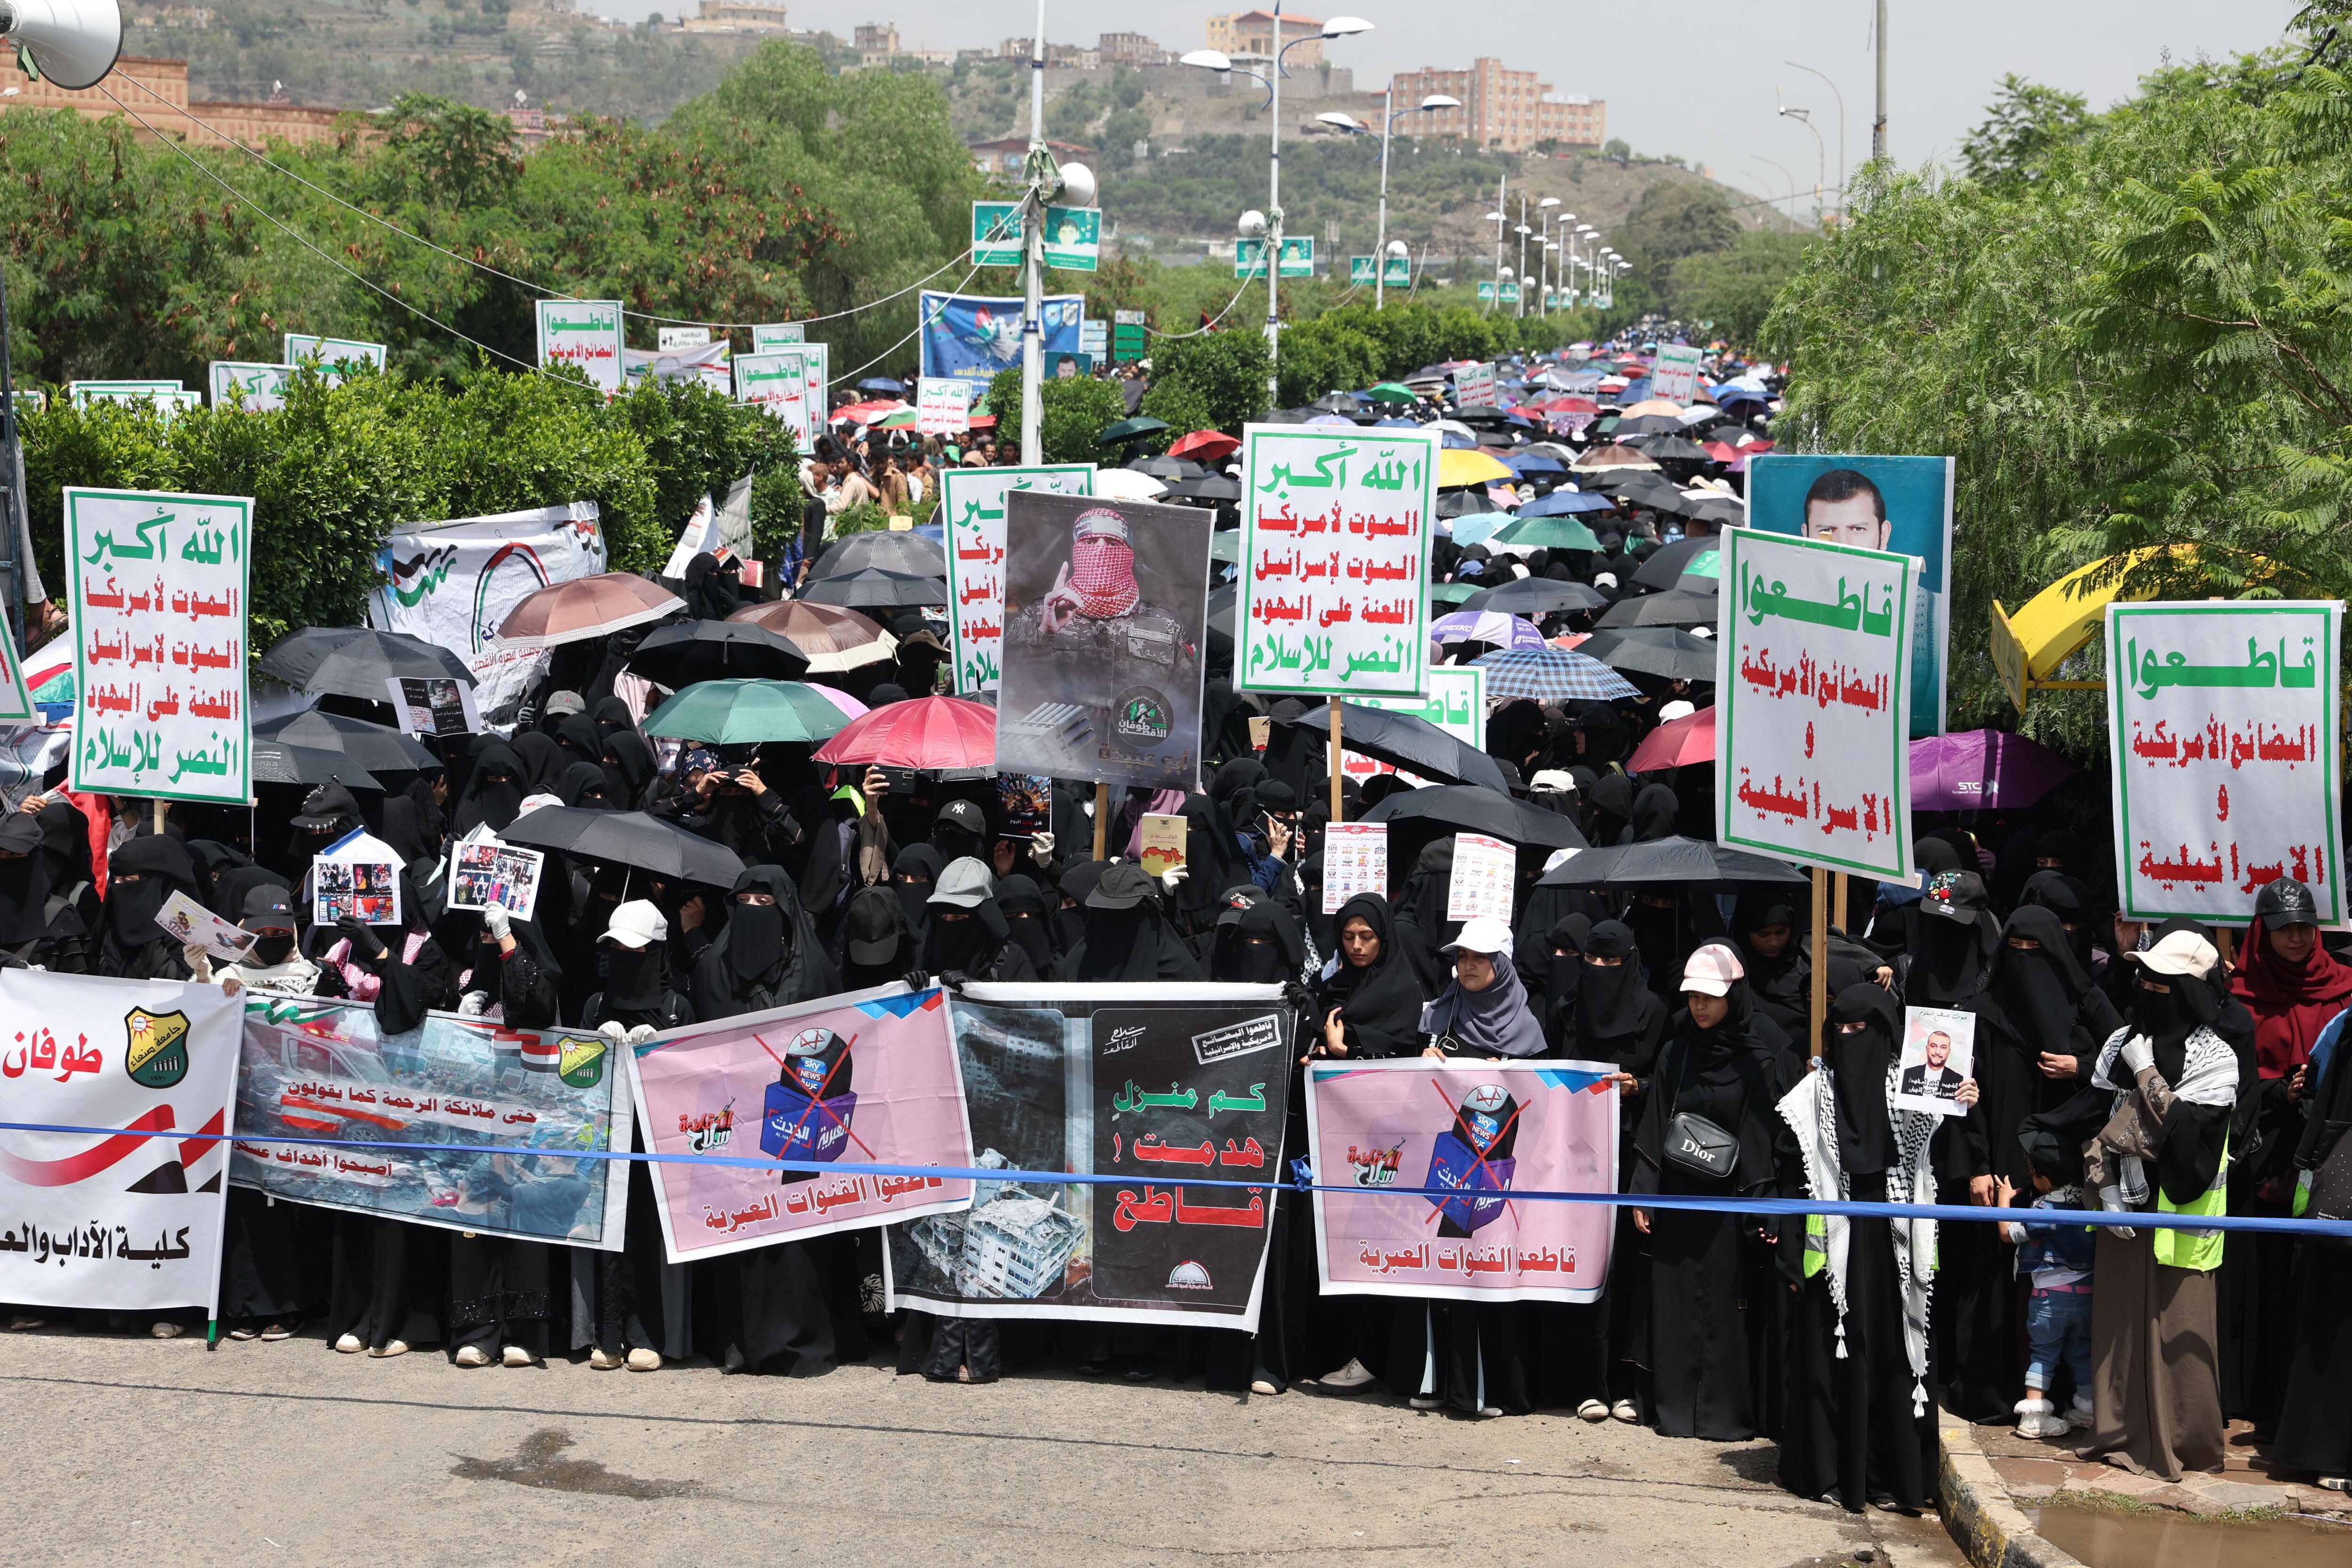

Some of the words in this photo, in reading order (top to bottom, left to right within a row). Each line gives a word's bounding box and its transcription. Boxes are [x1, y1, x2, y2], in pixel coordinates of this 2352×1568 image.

[546, 312, 614, 332] قاطعوا
[742, 363, 800, 385] قاطعوا
[1256, 441, 1359, 500] أكبر
[1360, 448, 1420, 492] الله
[1258, 499, 1342, 539] لأمريكا
[1348, 509, 1418, 541] الموت
[82, 506, 176, 573] أكبر
[181, 516, 238, 565] الله
[1255, 547, 1340, 585] لإسرائيل
[1346, 554, 1416, 585] الموت
[86, 573, 165, 617] لأمريكا
[171, 586, 238, 622] الموت
[1252, 593, 1311, 627] اليهود
[1319, 595, 1352, 628] على
[1360, 595, 1414, 626] اللعنة
[1741, 559, 1892, 637] قاطعوا
[87, 627, 165, 673] لإسرائيل
[171, 637, 238, 675] الموت
[1250, 632, 1333, 684] للإسلام
[1337, 633, 1412, 683] النصر
[483, 673, 501, 682] National
[501, 665, 523, 679] Campaign
[1740, 643, 1816, 700] الأمريكية
[2128, 636, 2315, 700] قاطعوا
[87, 681, 141, 720] اليهود
[147, 684, 180, 722] على
[188, 684, 238, 722] اللعنة
[1818, 659, 1889, 717] البضائع
[1119, 719, 1150, 732] طوفان
[1119, 728, 1167, 738] الأقصى
[1804, 721, 1815, 760] و
[2132, 712, 2226, 768] الأمريكية
[84, 725, 162, 786] للإسلام
[167, 730, 238, 785] النصر
[2231, 719, 2316, 771] البضائع
[1958, 781, 1982, 790] STC
[2216, 783, 2229, 822] و
[952, 803, 966, 814] NY
[1738, 766, 1891, 843] الإسرائيلية
[1246, 1020, 1272, 1037] قاطعوا
[1934, 1012, 1950, 1021] فلسطين
[154, 1027, 181, 1047] جامعة
[1202, 1029, 1245, 1047] البضائع
[1204, 1042, 1241, 1056] والإسرائيلية
[1242, 1032, 1273, 1047] الأمريكية
[2, 1027, 103, 1083] طوفان
[131, 1046, 156, 1067] صنعاء
[563, 1061, 581, 1073] صنعاء
[580, 1049, 598, 1062] جامعة
[804, 1059, 820, 1071] sky
[287, 1080, 343, 1098] يقولون
[800, 1069, 821, 1081] NEWS
[348, 1086, 376, 1104] كما
[382, 1091, 438, 1113] الرحمة
[444, 1097, 496, 1119] ملائكة
[1208, 1082, 1267, 1119] كم
[502, 1106, 539, 1125] حتى
[1472, 1124, 1491, 1139] NEWS
[1477, 1115, 1492, 1129] sky
[685, 1123, 731, 1156] سلاح
[1134, 1133, 1264, 1168] هدمت
[1680, 1138, 1716, 1163] Dior
[276, 1149, 328, 1168] أهداف
[334, 1155, 392, 1178] أصبحوا
[1353, 1160, 1398, 1187] سلاح
[787, 1173, 867, 1217] القنوات
[1113, 1186, 1264, 1232] قاطع
[704, 1192, 780, 1236] العبرية
[52, 1220, 112, 1267] الآداب
[116, 1225, 190, 1270] كلية
[1359, 1240, 1430, 1276] العبرية
[1437, 1242, 1511, 1278] القنوات
